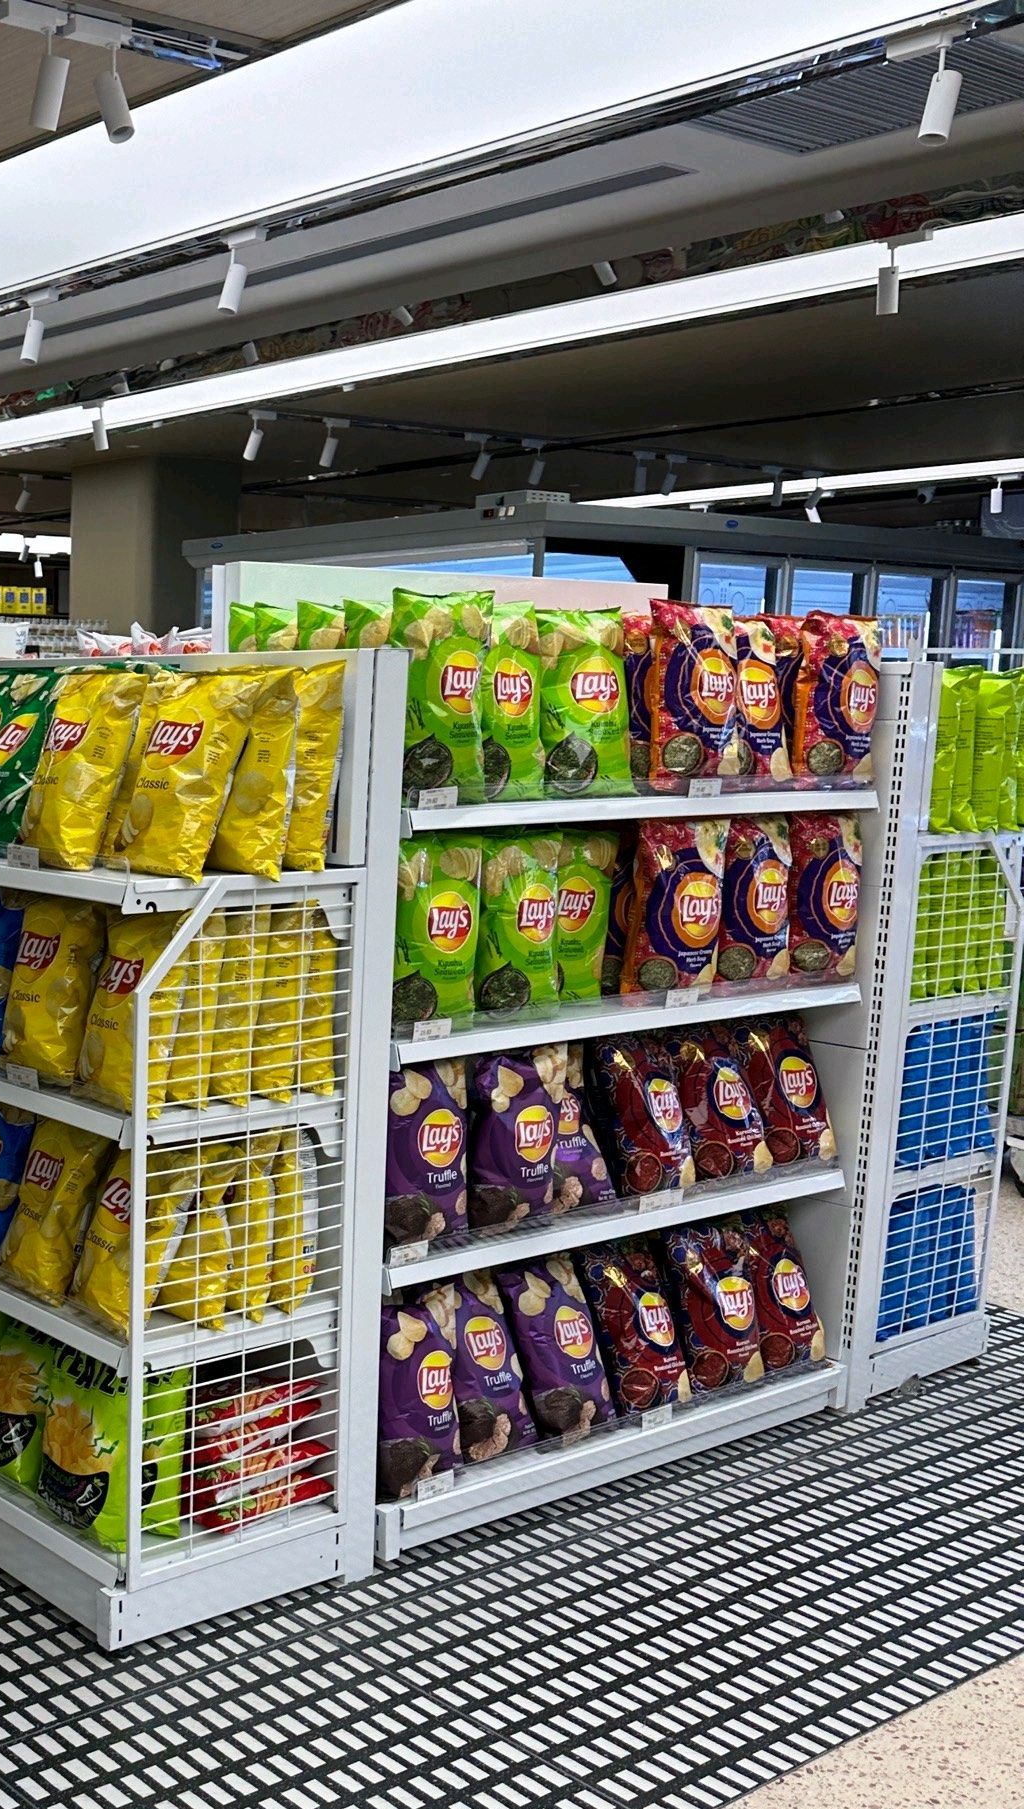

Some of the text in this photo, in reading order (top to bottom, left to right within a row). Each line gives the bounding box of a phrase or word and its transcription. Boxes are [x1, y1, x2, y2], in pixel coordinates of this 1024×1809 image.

[496, 670, 530, 704] Lay's
[575, 671, 618, 701] Lay's
[702, 672, 735, 702] Lay's
[742, 680, 777, 708] Lay's
[850, 682, 876, 712] Lay's
[147, 720, 201, 756] Lay's
[136, 777, 170, 790] Classic
[558, 889, 594, 919] Lay's
[682, 894, 719, 925] Lay's
[757, 882, 787, 911] Lay's
[431, 905, 469, 939] Lay's
[520, 896, 555, 928] Lay's
[17, 932, 59, 970] Lay's
[11, 990, 41, 1003] Classic
[90, 1013, 120, 1030] Classic
[782, 1068, 815, 1096] Lay's
[649, 1091, 680, 1120] Lay's
[422, 1122, 461, 1154] Lay's
[518, 1118, 552, 1149] Lay's
[559, 1136, 587, 1149] ruffle
[427, 1169, 458, 1184] Truffle
[520, 1163, 549, 1179] Truffle
[776, 1269, 806, 1298] Lay's
[719, 1288, 752, 1318] Lay's
[556, 1315, 589, 1346] Lay's
[643, 1304, 671, 1334] Lay's
[468, 1325, 503, 1358] Lay's
[484, 1371, 513, 1387] Truffle
[570, 1359, 596, 1375] Truffle
